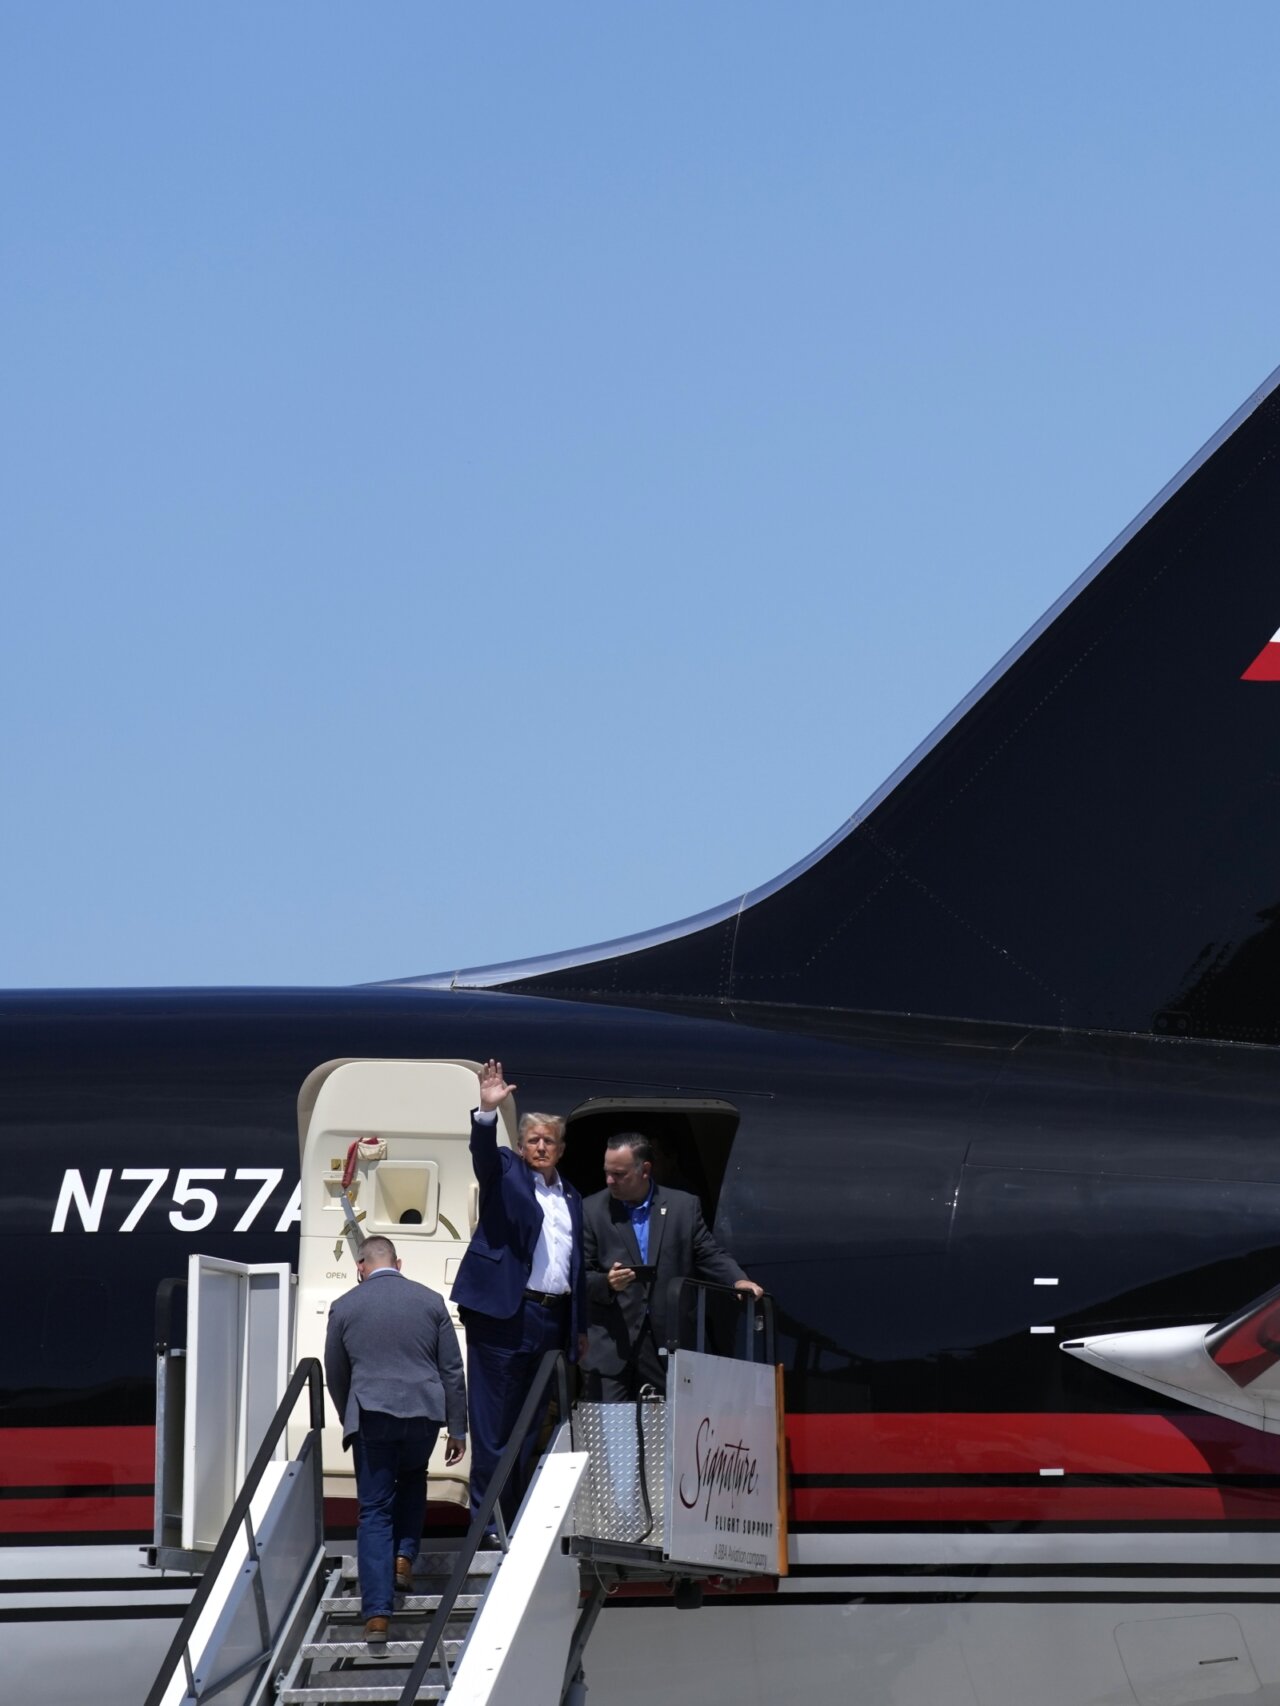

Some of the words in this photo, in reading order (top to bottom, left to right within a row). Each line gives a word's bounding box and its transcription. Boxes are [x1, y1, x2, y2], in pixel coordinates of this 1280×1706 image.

[679, 1417, 758, 1522] Signature
[715, 1515, 740, 1534] FLIGHT
[743, 1519, 773, 1538] SUPPORT
[746, 1552, 767, 1570] company
